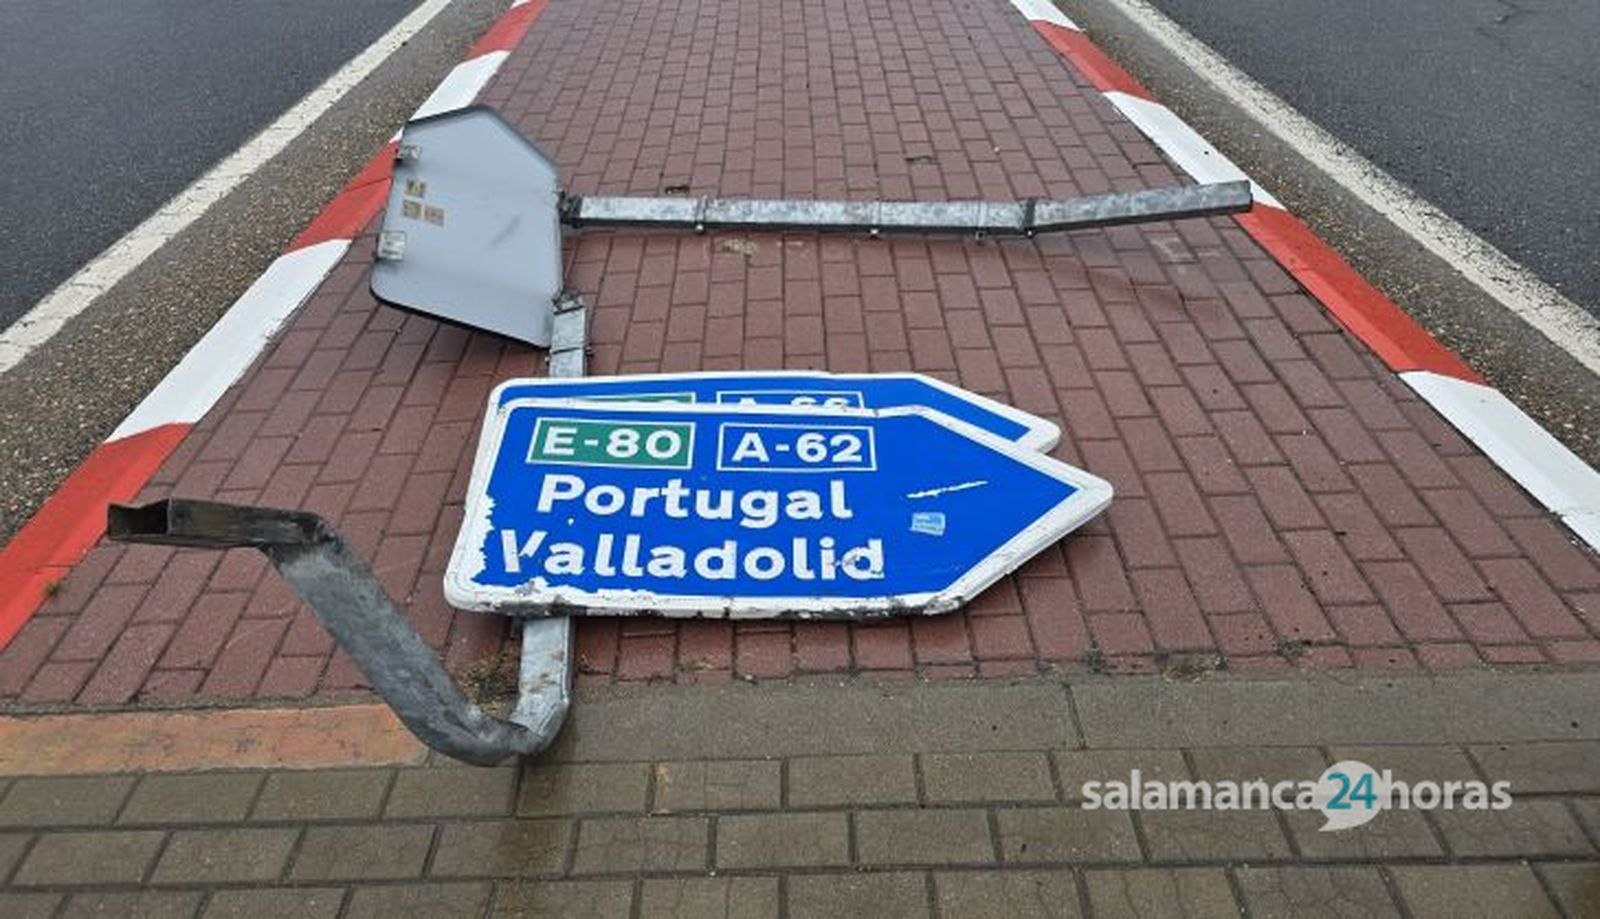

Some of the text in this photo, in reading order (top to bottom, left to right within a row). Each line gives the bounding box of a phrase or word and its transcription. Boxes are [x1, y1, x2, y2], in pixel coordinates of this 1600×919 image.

[541, 426, 683, 459] E-80
[731, 431, 864, 463] A-62
[536, 473, 854, 528] Portugal
[499, 528, 886, 581] Valladolid
